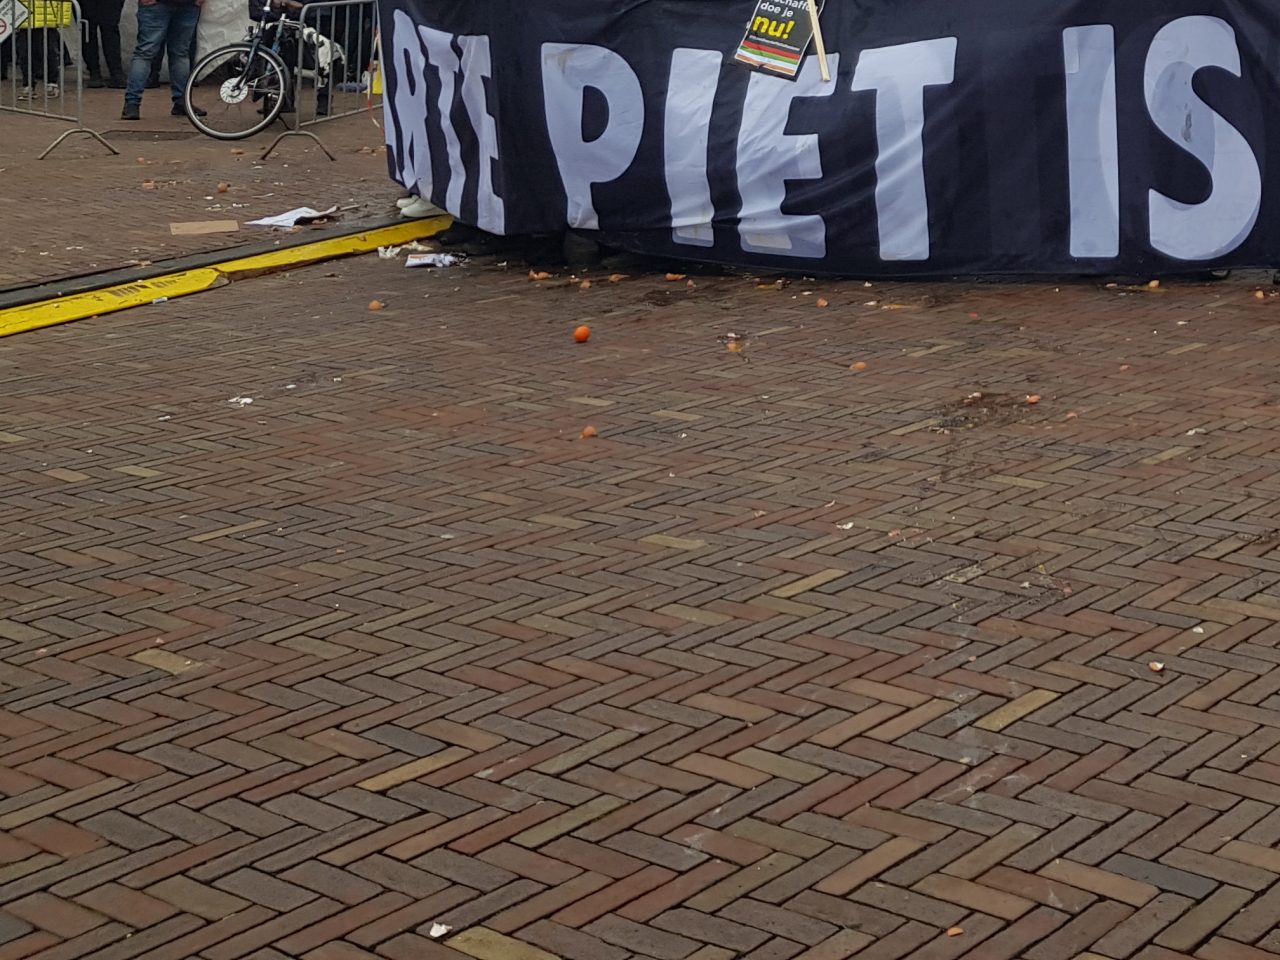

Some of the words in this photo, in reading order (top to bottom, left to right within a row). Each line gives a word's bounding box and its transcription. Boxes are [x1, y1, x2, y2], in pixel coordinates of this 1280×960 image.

[760, 2, 781, 14] doe
[781, 7, 794, 18] je
[752, 16, 795, 40] nu!
[541, 37, 957, 261] PIET
[1063, 15, 1262, 262] IS
